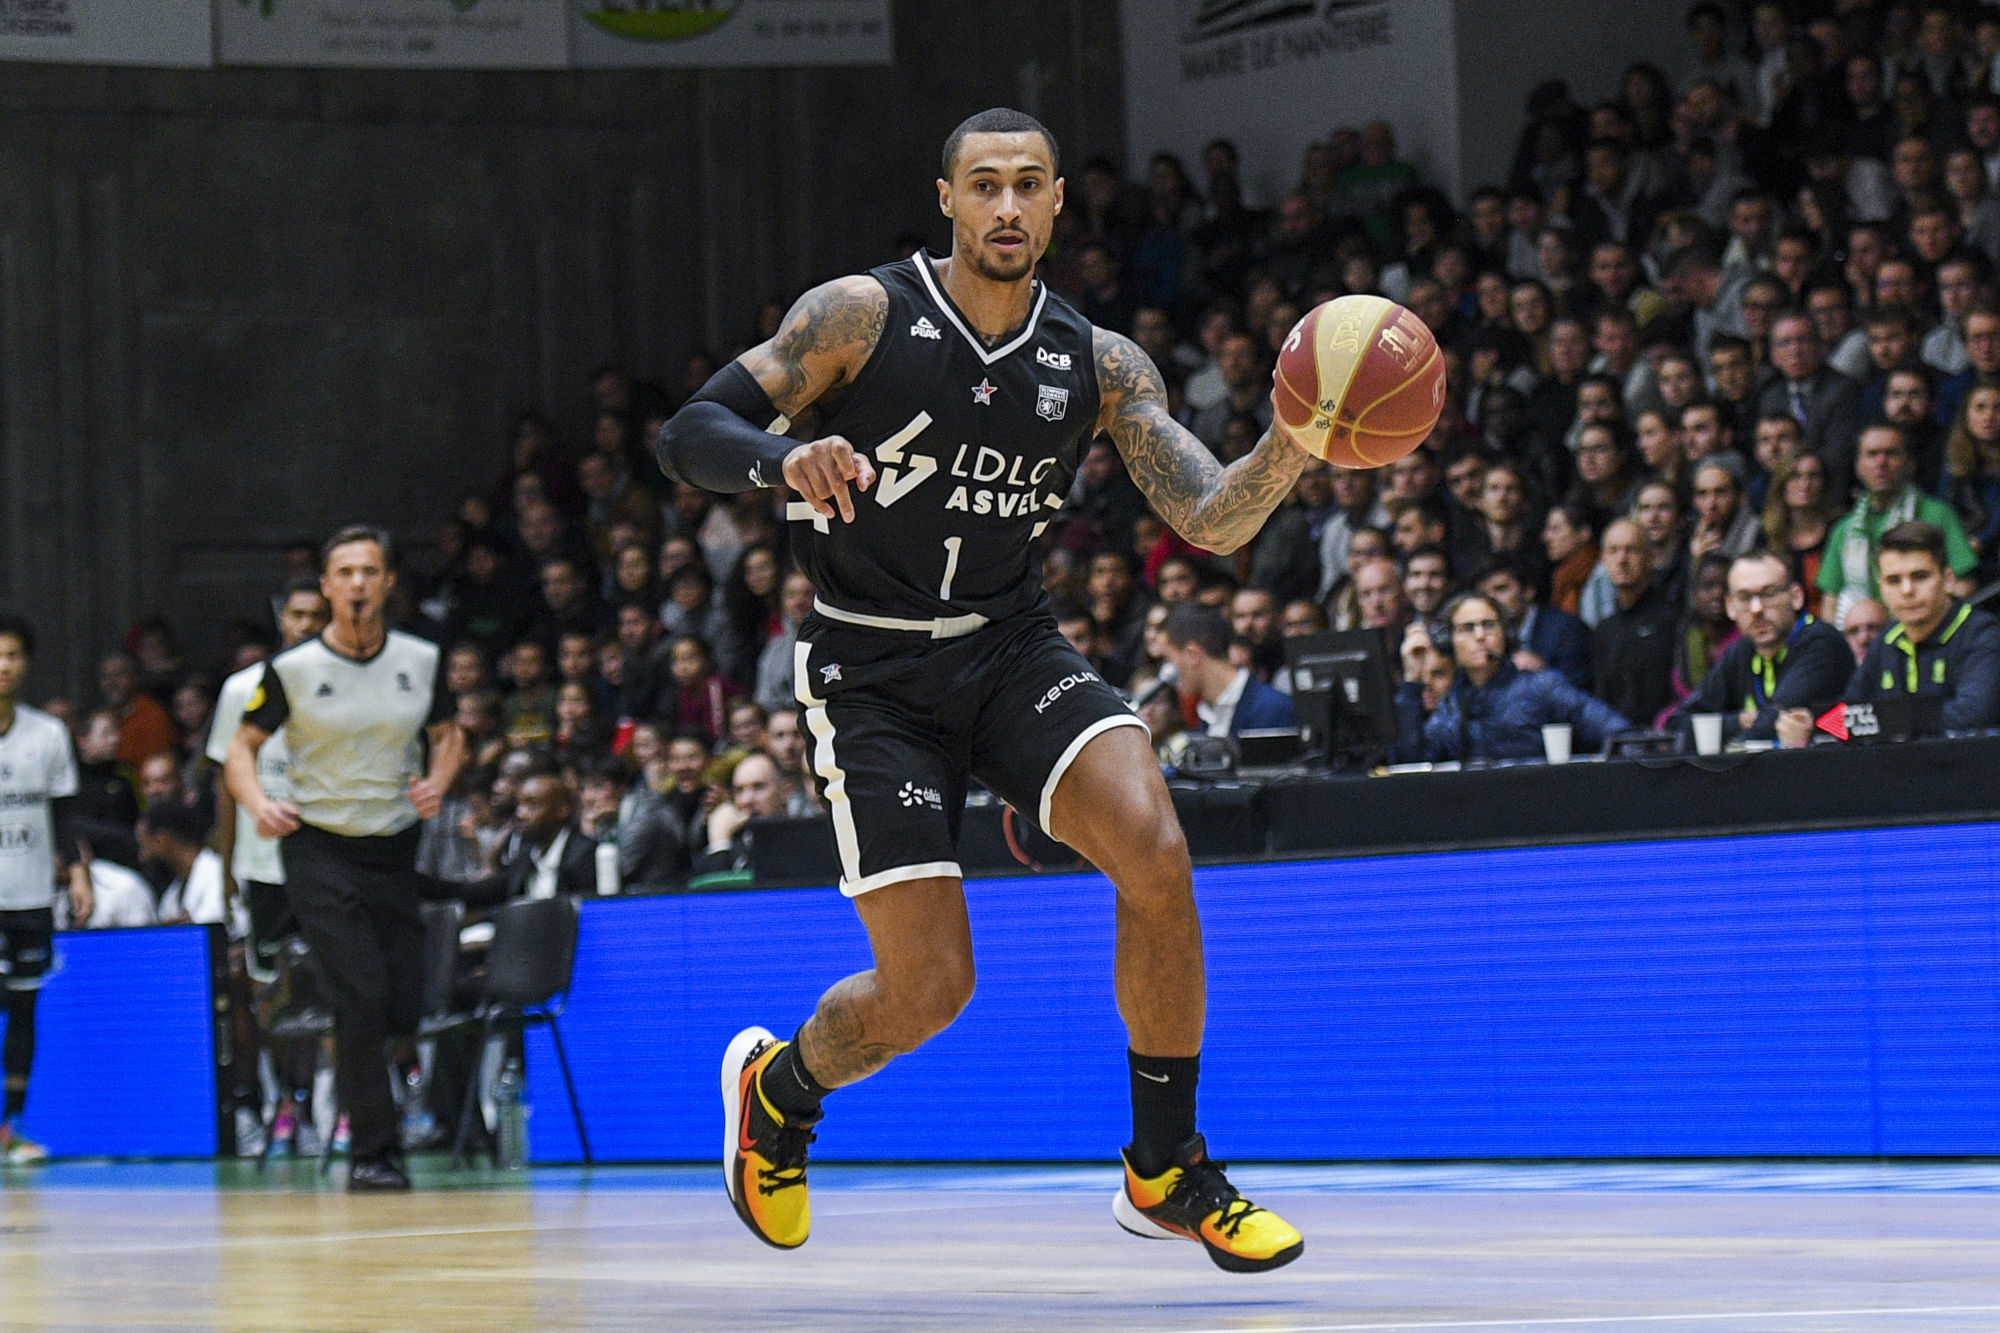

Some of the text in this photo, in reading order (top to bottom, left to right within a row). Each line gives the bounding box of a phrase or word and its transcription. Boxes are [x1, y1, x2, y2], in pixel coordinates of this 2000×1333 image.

[910, 324, 942, 341] PEAK
[1036, 346, 1072, 367] DCB
[950, 443, 1057, 486] LDLC
[944, 486, 1040, 518] ASVEL
[940, 536, 962, 601] 1
